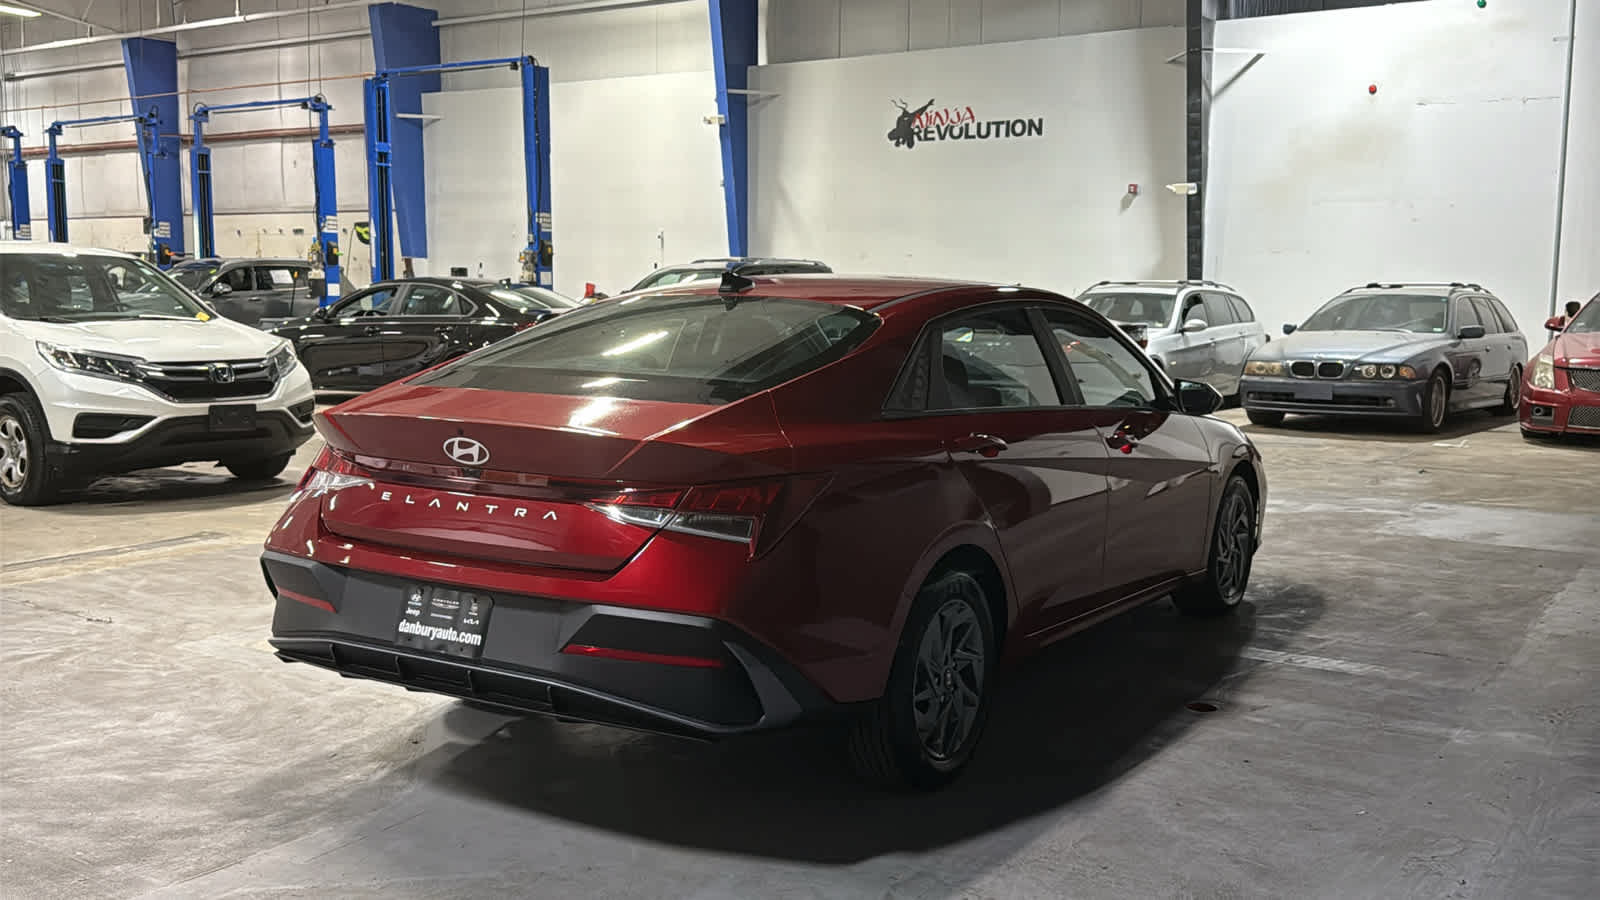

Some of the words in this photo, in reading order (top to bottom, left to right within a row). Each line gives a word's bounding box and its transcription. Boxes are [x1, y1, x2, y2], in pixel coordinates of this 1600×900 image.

[912, 118, 1043, 141] REVOLUTION
[381, 491, 557, 521] ELANTRA
[398, 619, 482, 646] danburyauto.com
